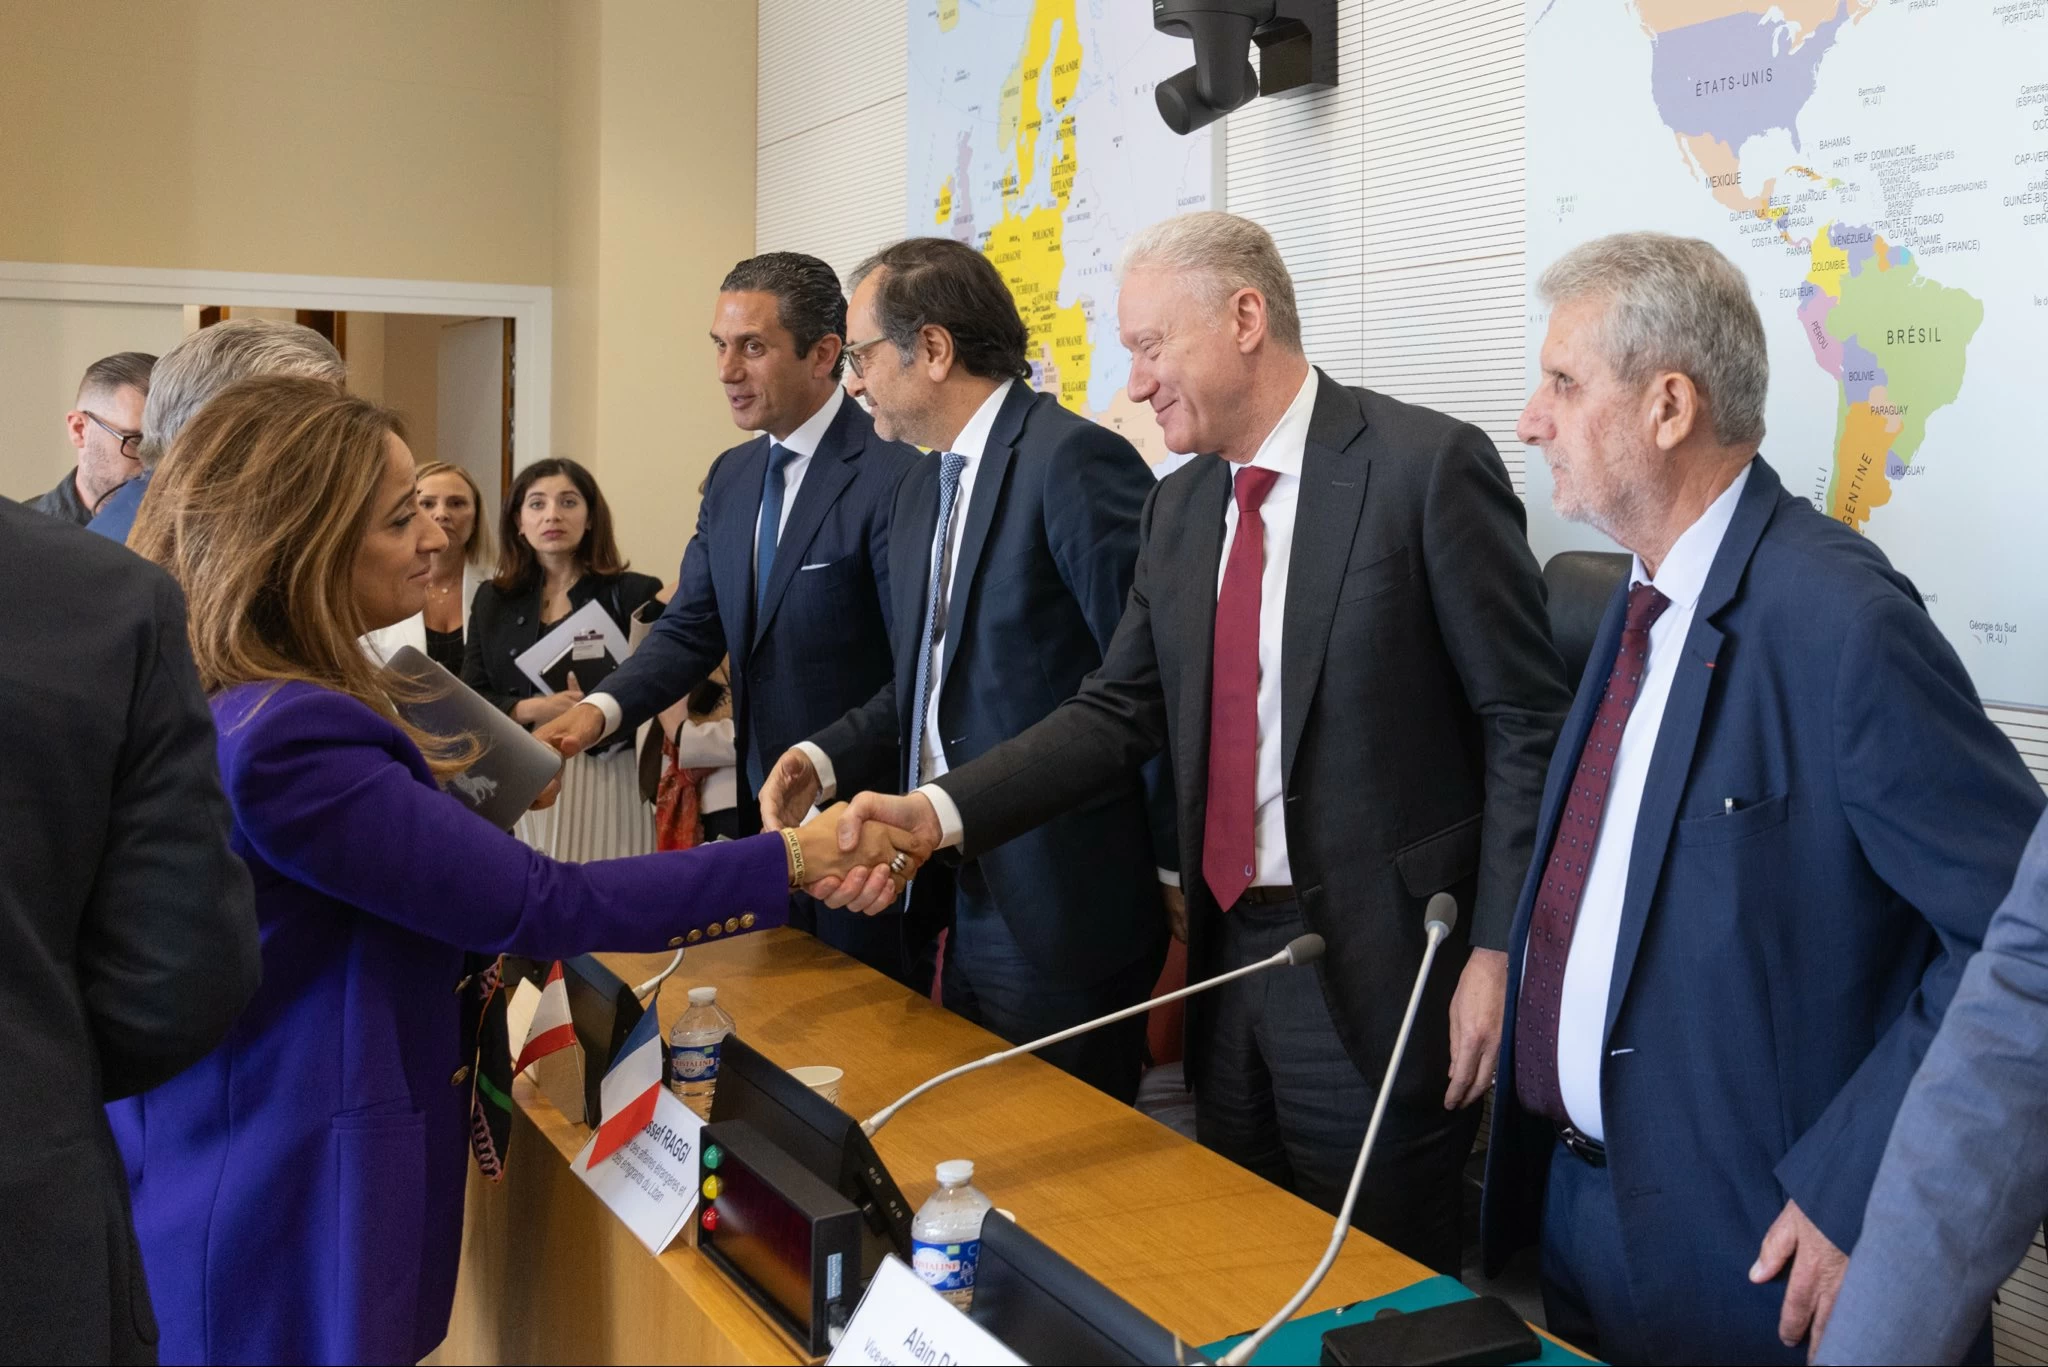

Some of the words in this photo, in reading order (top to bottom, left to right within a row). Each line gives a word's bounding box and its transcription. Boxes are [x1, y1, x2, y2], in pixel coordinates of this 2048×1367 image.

[1696, 68, 1773, 96] ÉTATS-UNIS
[1858, 84, 1886, 97] Bermudes
[1820, 136, 1851, 150] BAHAMAS
[1871, 145, 1917, 161] DOMINICAINE
[1796, 167, 1814, 178] CUBA
[1705, 171, 1742, 189] MEXIQUE
[1769, 195, 1791, 207] BELIZE
[1729, 208, 1766, 222] GUATEMALA
[1771, 203, 1807, 218] HONDURAS
[1739, 221, 1772, 235] SALVADOR
[1777, 216, 1814, 231] NICARAGUA
[1888, 227, 1918, 240] GUYANA
[1752, 237, 1772, 248] COSTA
[1773, 234, 1788, 246] RICA
[1904, 234, 1941, 248] SURINAME
[1918, 243, 1943, 257] Guyane
[1945, 239, 1980, 254] (FRANCE)
[1786, 245, 1813, 257] PANAMA
[1811, 260, 1846, 272] COLOMBIE
[1811, 320, 1829, 350] PÉROU
[1887, 325, 1942, 346] BRÉSIL
[1849, 370, 1875, 382] BOLIVIE
[1870, 405, 1908, 417] PARAGUAY
[1891, 465, 1925, 477] URUGUAY
[1813, 467, 1828, 513] CHILI
[1842, 453, 1872, 526] GENTINE
[1969, 619, 1994, 634] Géorgie
[1995, 622, 2004, 632] du
[2004, 621, 2018, 633] Sud
[661, 1128, 693, 1164] RAGGI
[903, 1327, 936, 1366] Alain
